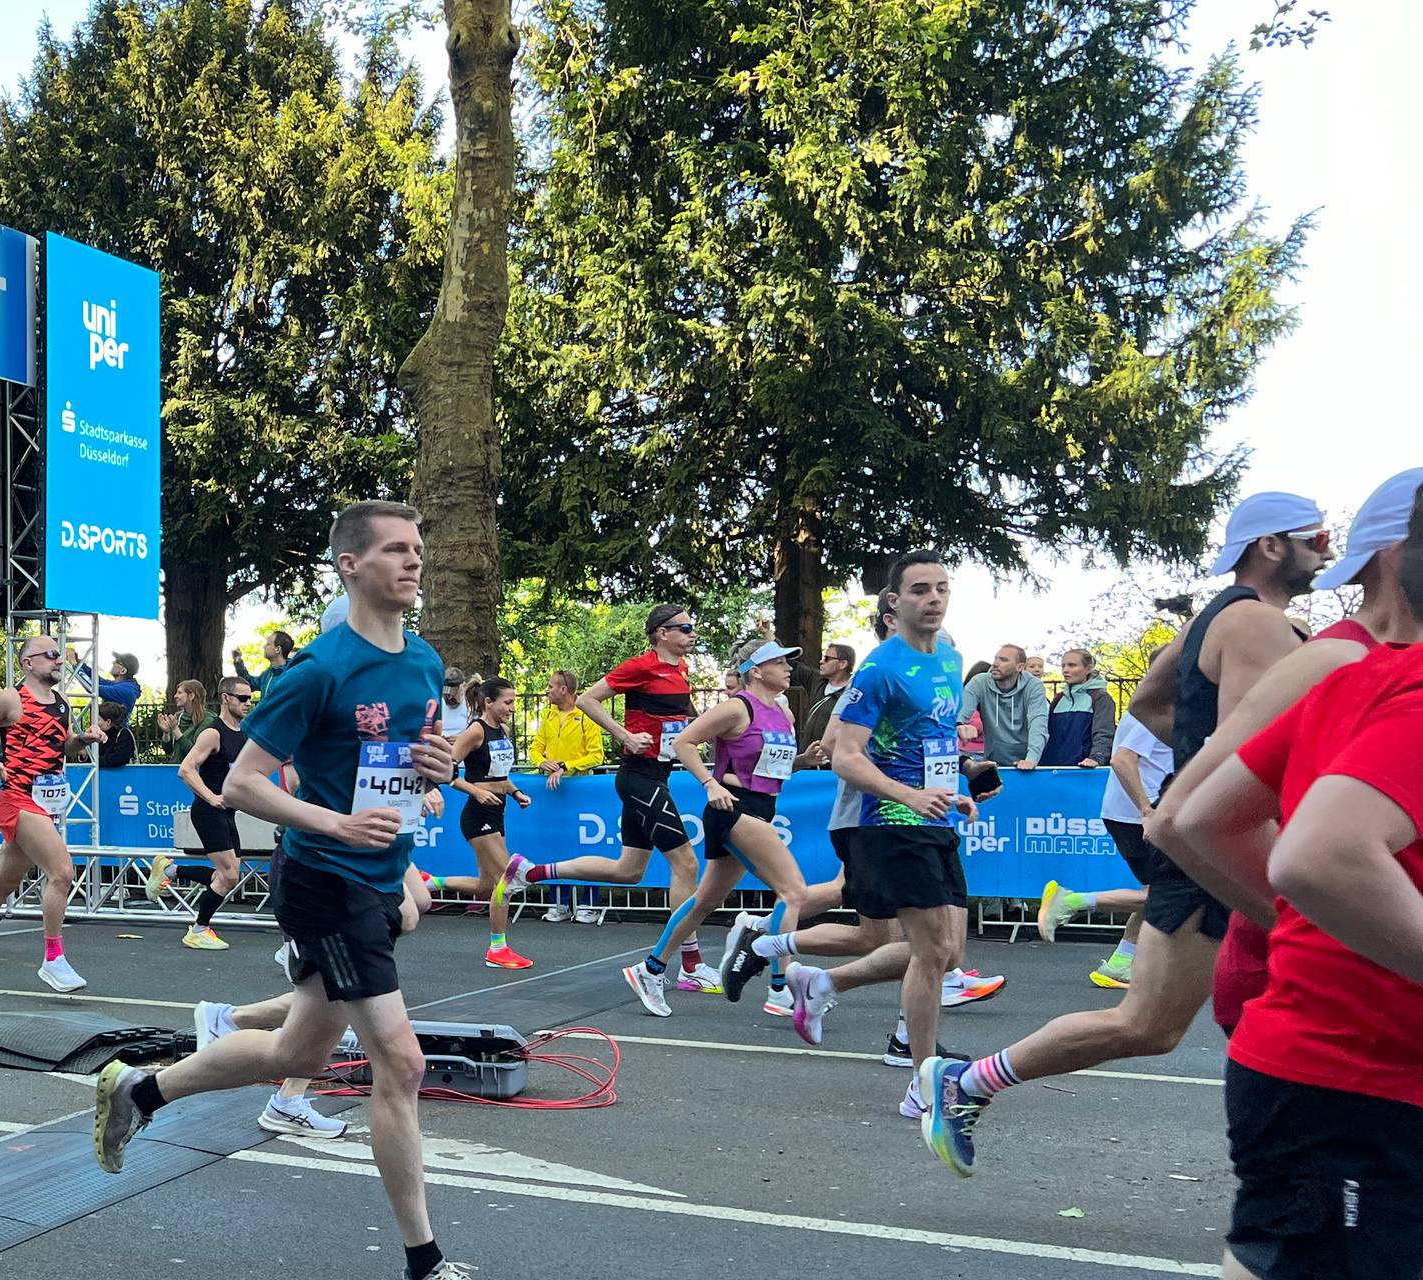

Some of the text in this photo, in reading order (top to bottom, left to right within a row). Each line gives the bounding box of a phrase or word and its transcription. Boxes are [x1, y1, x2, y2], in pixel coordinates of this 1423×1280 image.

[82, 299, 117, 339] uni
[89, 332, 129, 370] per
[79, 420, 148, 451] Stadtsparkasse
[79, 443, 129, 469] Düsseldorf
[61, 520, 148, 560] D.SPORTS
[935, 761, 960, 775] 279
[370, 775, 424, 795] 4042
[413, 825, 444, 847] er
[958, 816, 996, 836] uni
[966, 836, 1010, 857] per
[731, 949, 748, 972] HOKA
